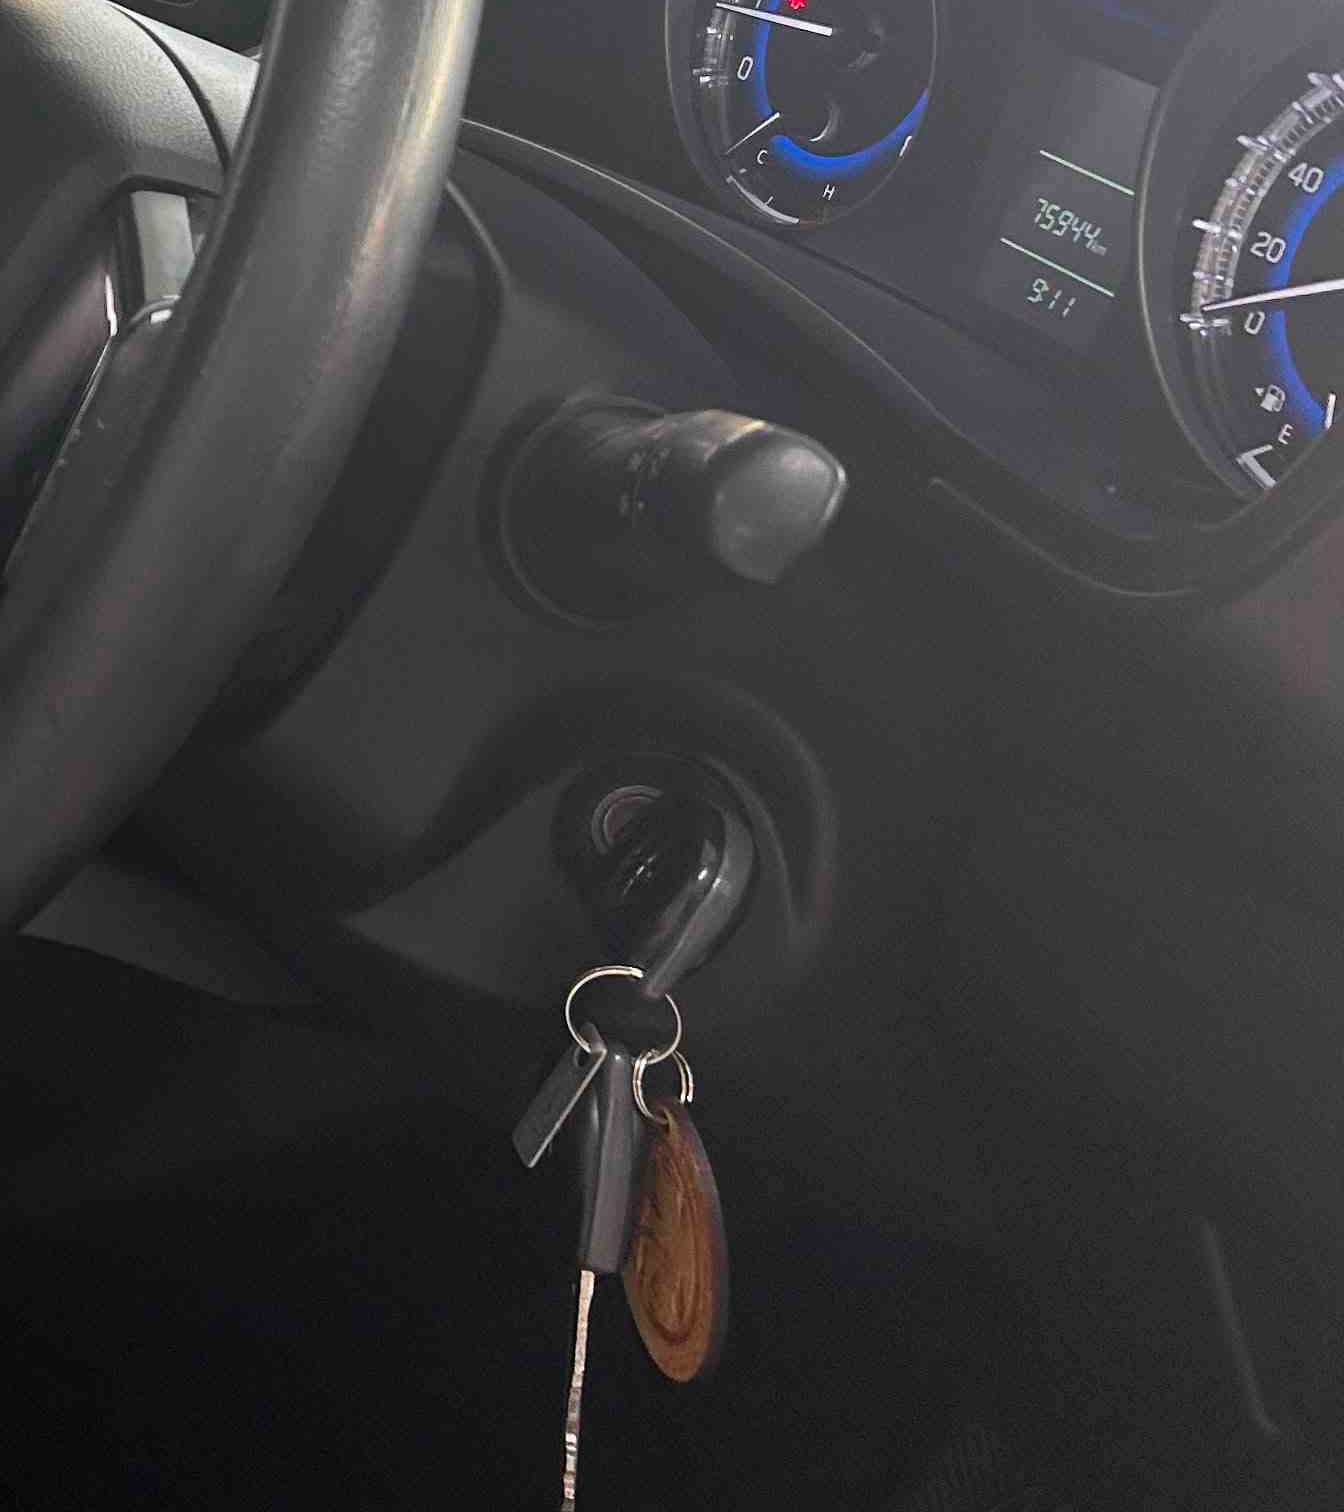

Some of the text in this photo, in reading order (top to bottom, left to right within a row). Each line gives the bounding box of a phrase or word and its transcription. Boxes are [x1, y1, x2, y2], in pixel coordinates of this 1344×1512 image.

[736, 55, 754, 81] 0
[756, 149, 769, 165] C
[1287, 162, 1324, 193] 40
[822, 183, 836, 201] H
[1034, 198, 1102, 249] 75944
[1250, 231, 1287, 264] 20
[1243, 310, 1266, 336] 0
[1277, 422, 1294, 446] E
